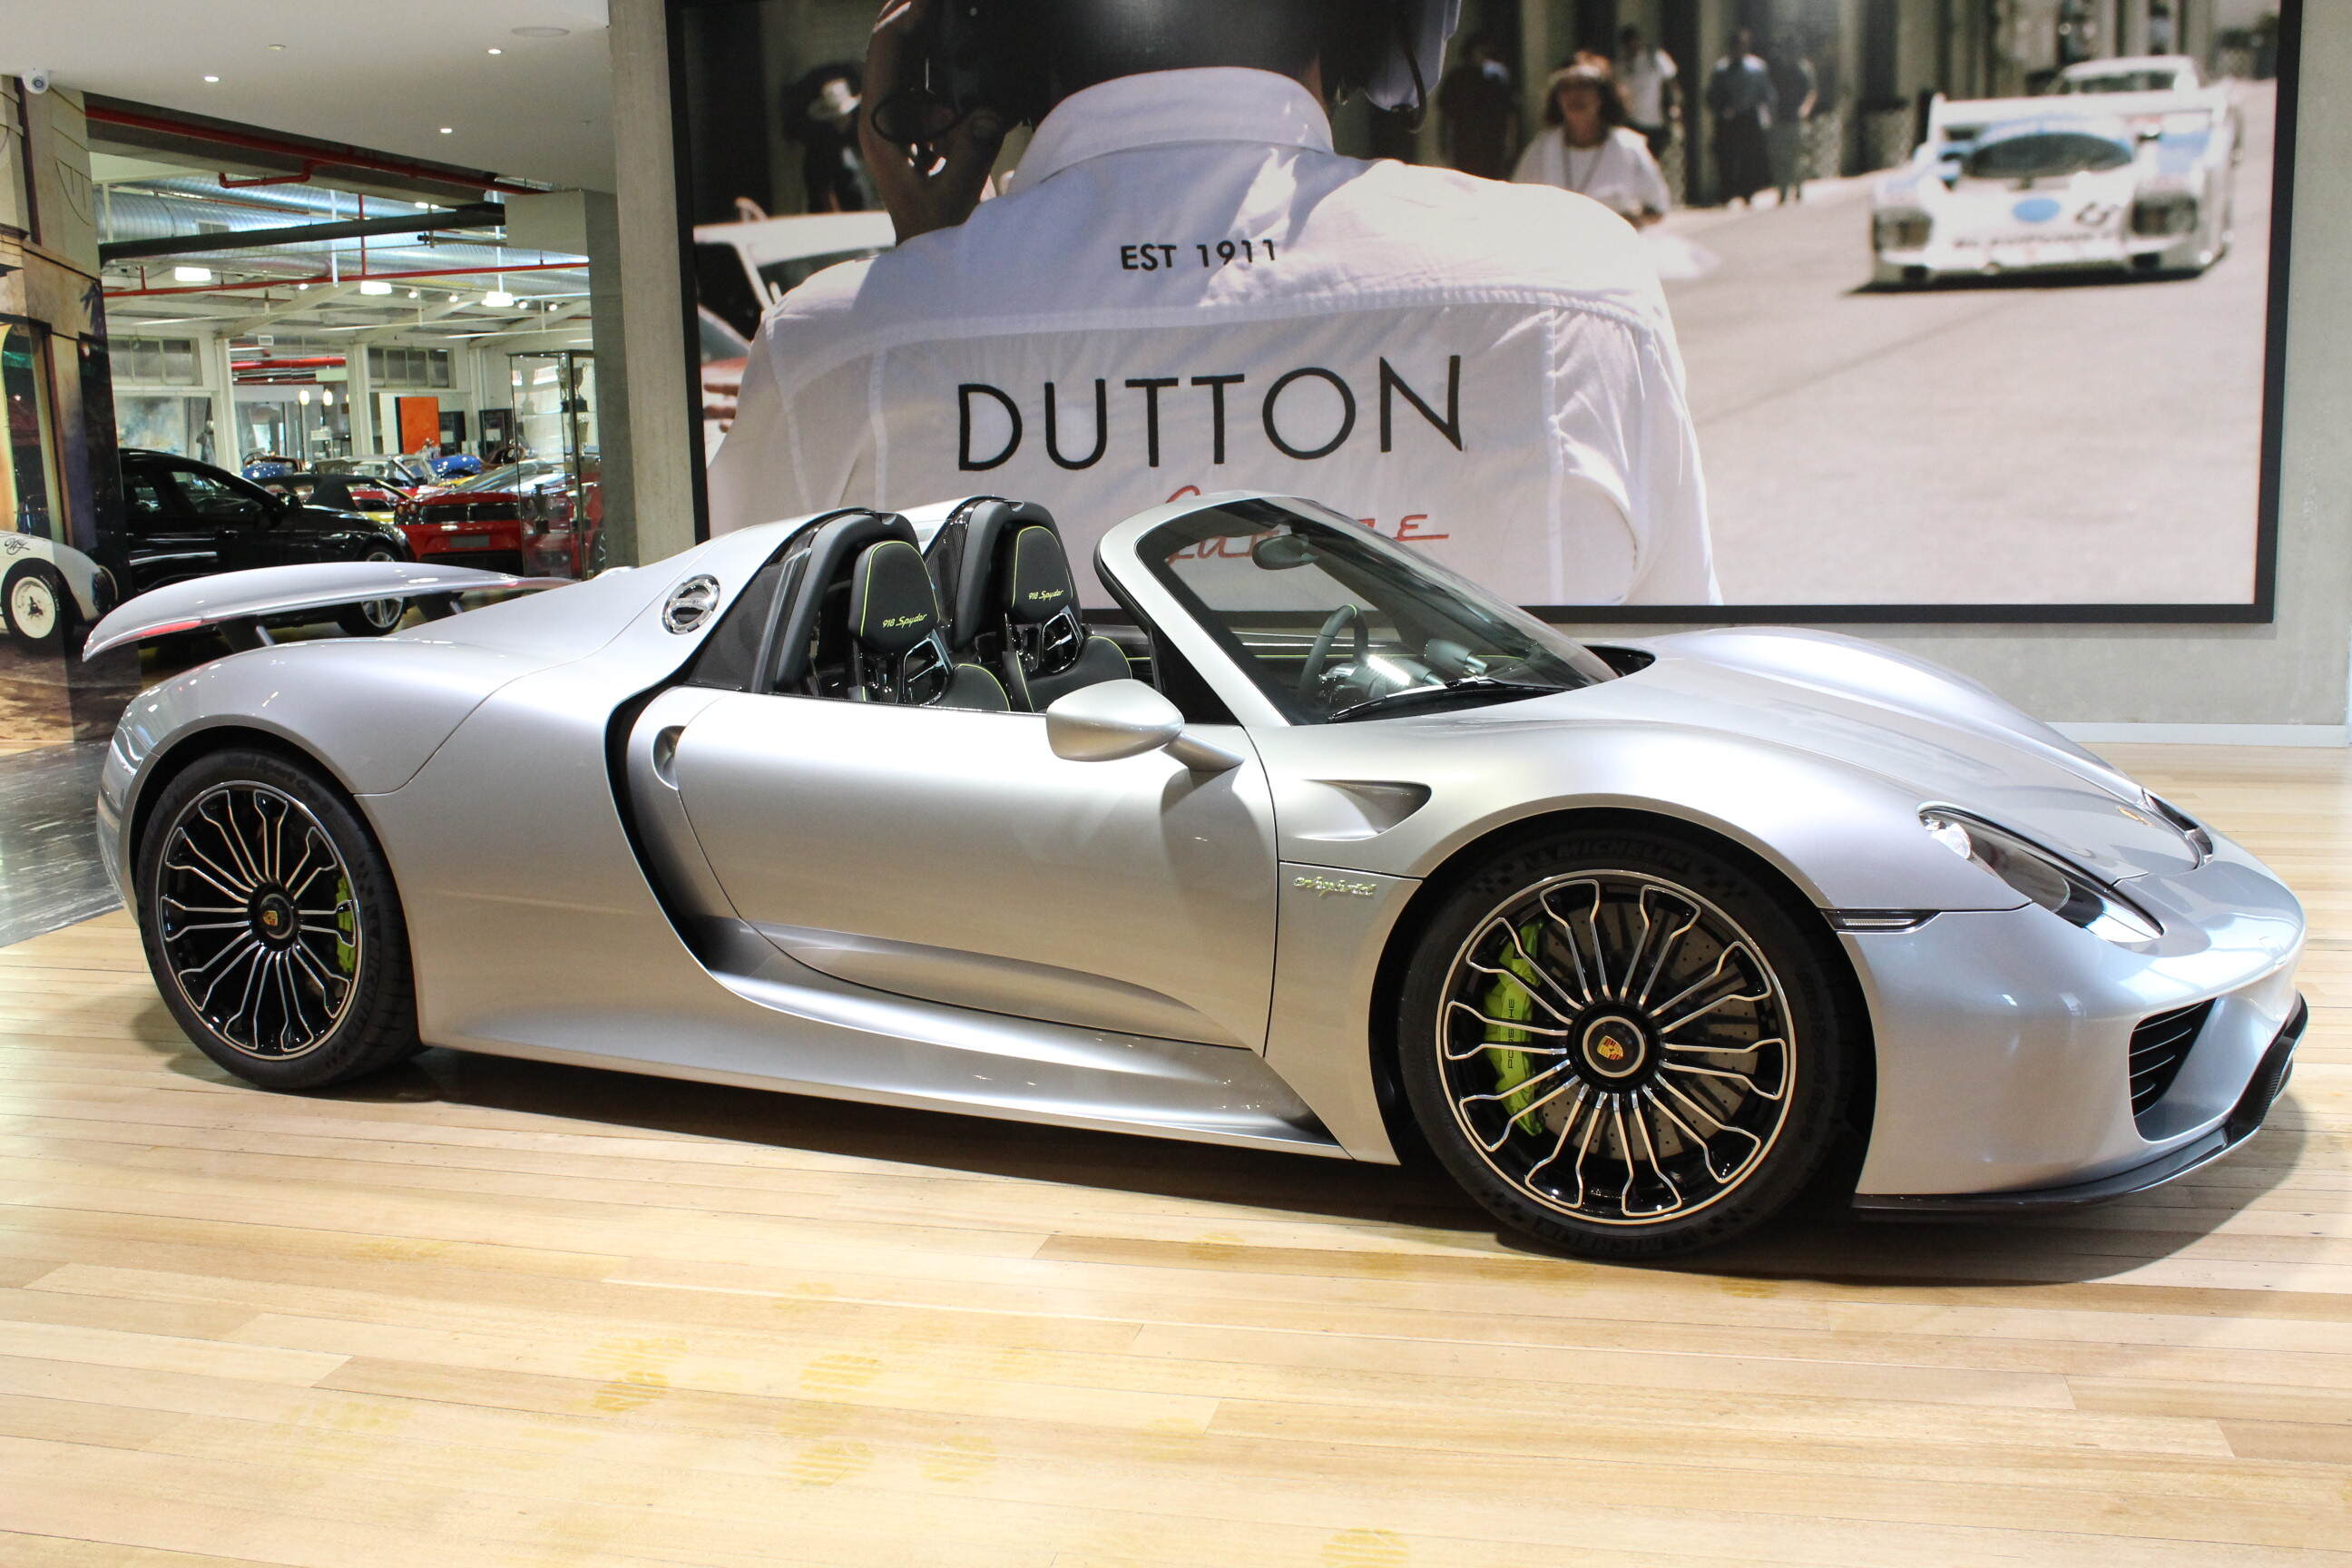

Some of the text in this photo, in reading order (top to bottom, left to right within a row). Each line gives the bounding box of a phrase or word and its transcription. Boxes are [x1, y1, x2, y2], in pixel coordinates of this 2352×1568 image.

[1120, 239, 1275, 270] EST 1911
[958, 355, 1463, 471] DUTTON
[1038, 589, 1064, 602] Spyder
[882, 612, 927, 629] 918 Spyder
